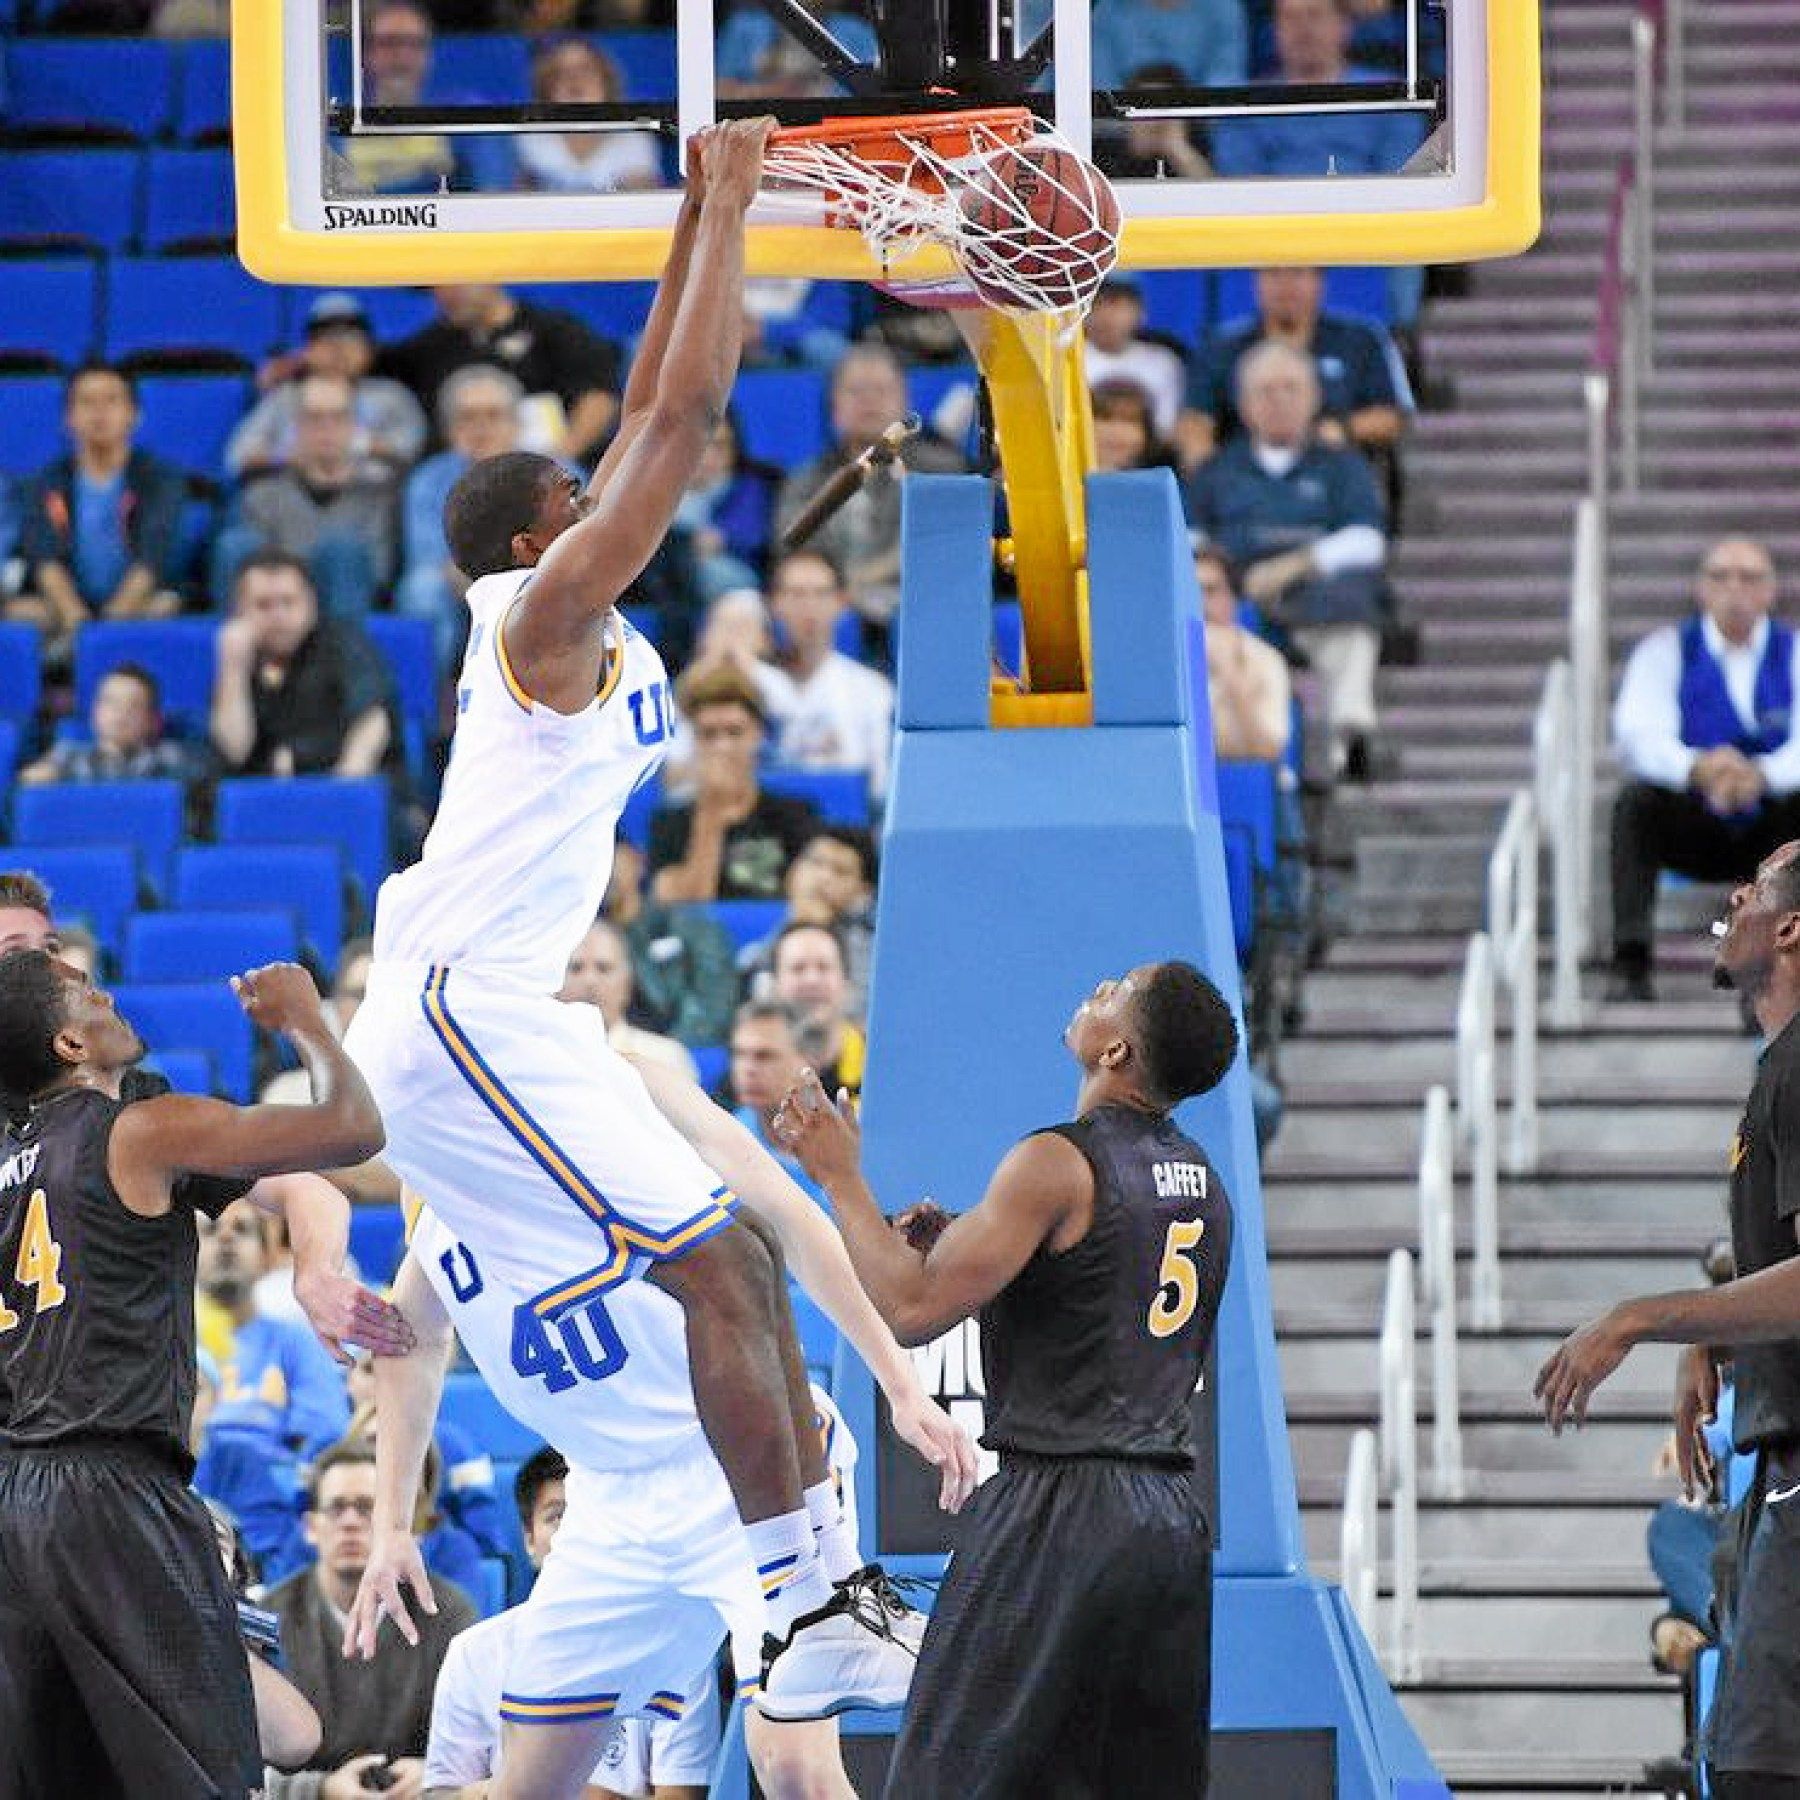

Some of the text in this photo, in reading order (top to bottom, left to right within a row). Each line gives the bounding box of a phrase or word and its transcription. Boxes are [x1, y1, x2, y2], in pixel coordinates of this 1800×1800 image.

[324, 203, 437, 230] SPALDING
[1152, 1161, 1207, 1199] CAFFEY
[1148, 1217, 1204, 1338] 5
